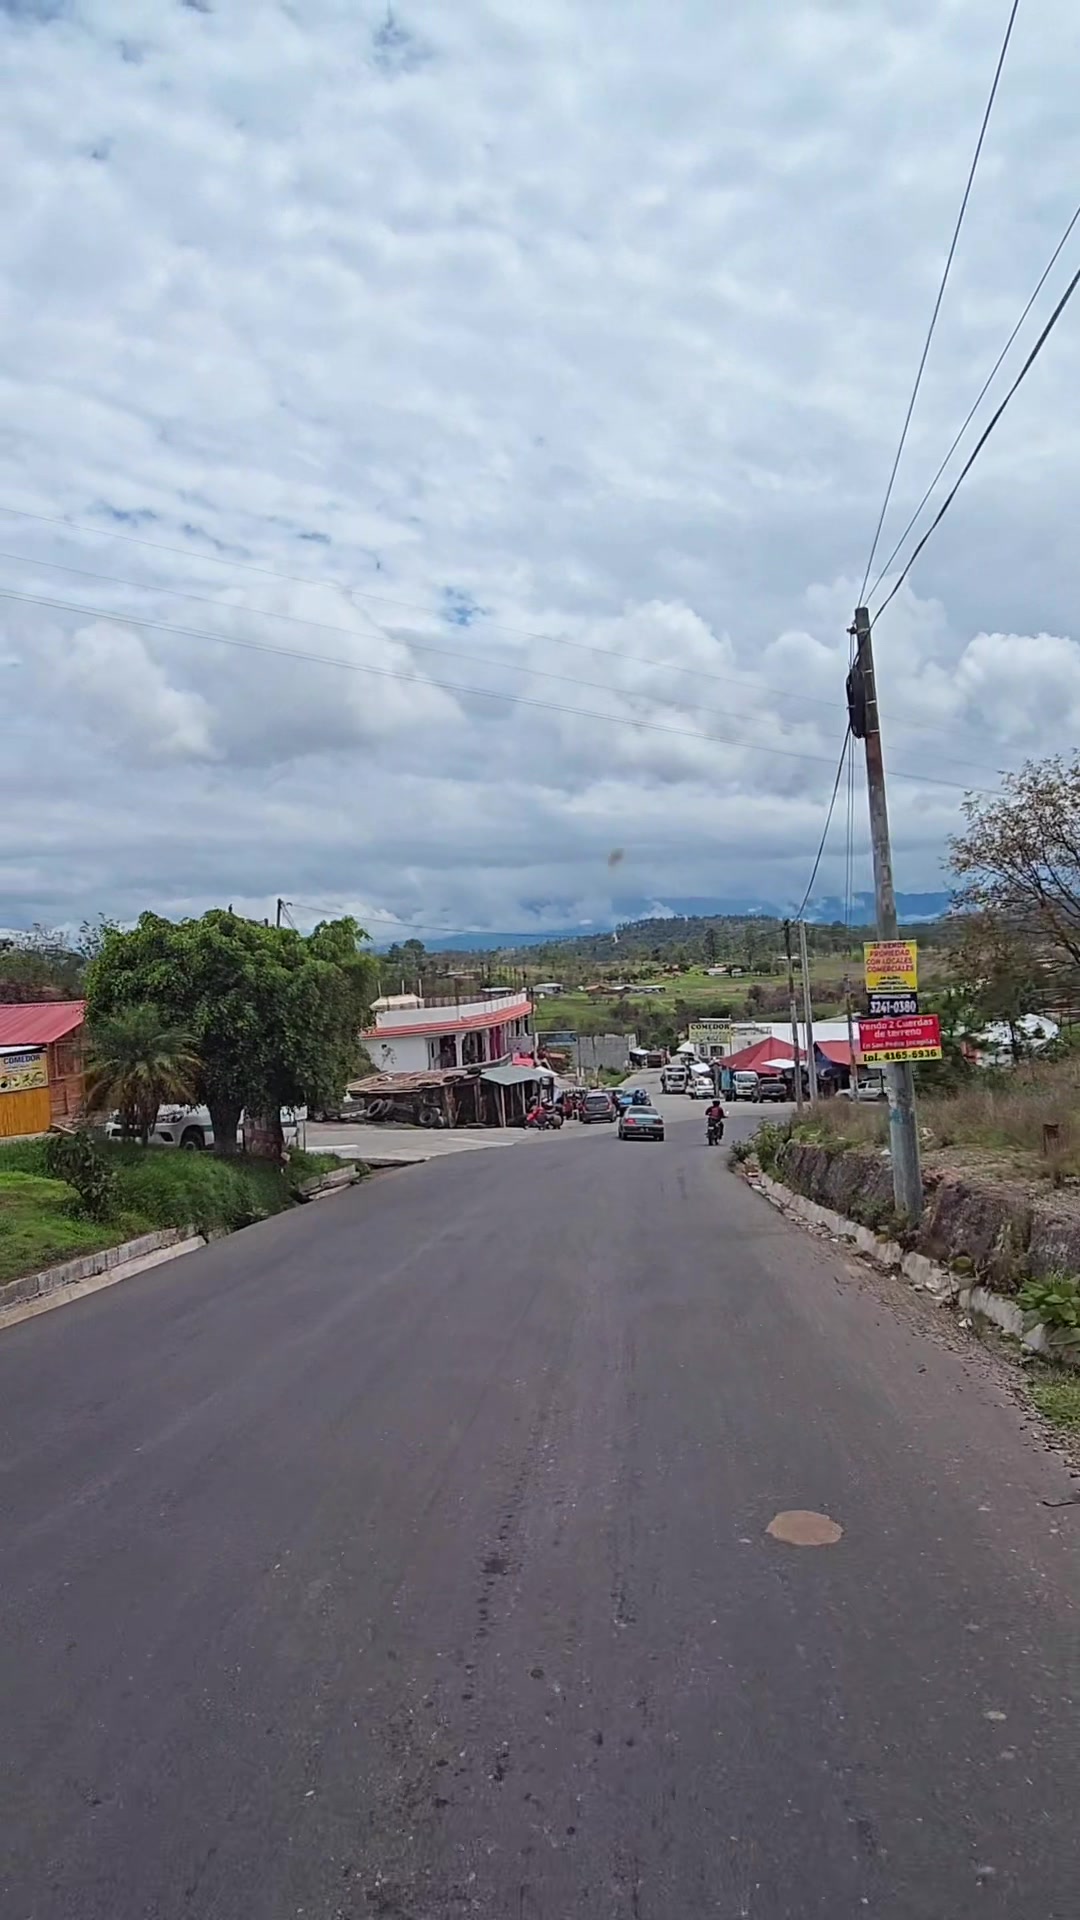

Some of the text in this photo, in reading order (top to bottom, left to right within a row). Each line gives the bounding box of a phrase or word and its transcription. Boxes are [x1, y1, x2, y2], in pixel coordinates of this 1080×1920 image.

[870, 949, 910, 957] PROPIEDAD
[882, 956, 912, 964] LOCALES
[867, 964, 913, 973] COMERCIALES
[870, 1000, 916, 1013] 3241-0380
[860, 1022, 887, 1031] Vendo
[896, 1018, 933, 1028] Cuerdas
[874, 1028, 922, 1038] de terreno
[4, 1055, 41, 1064] COMEDOR
